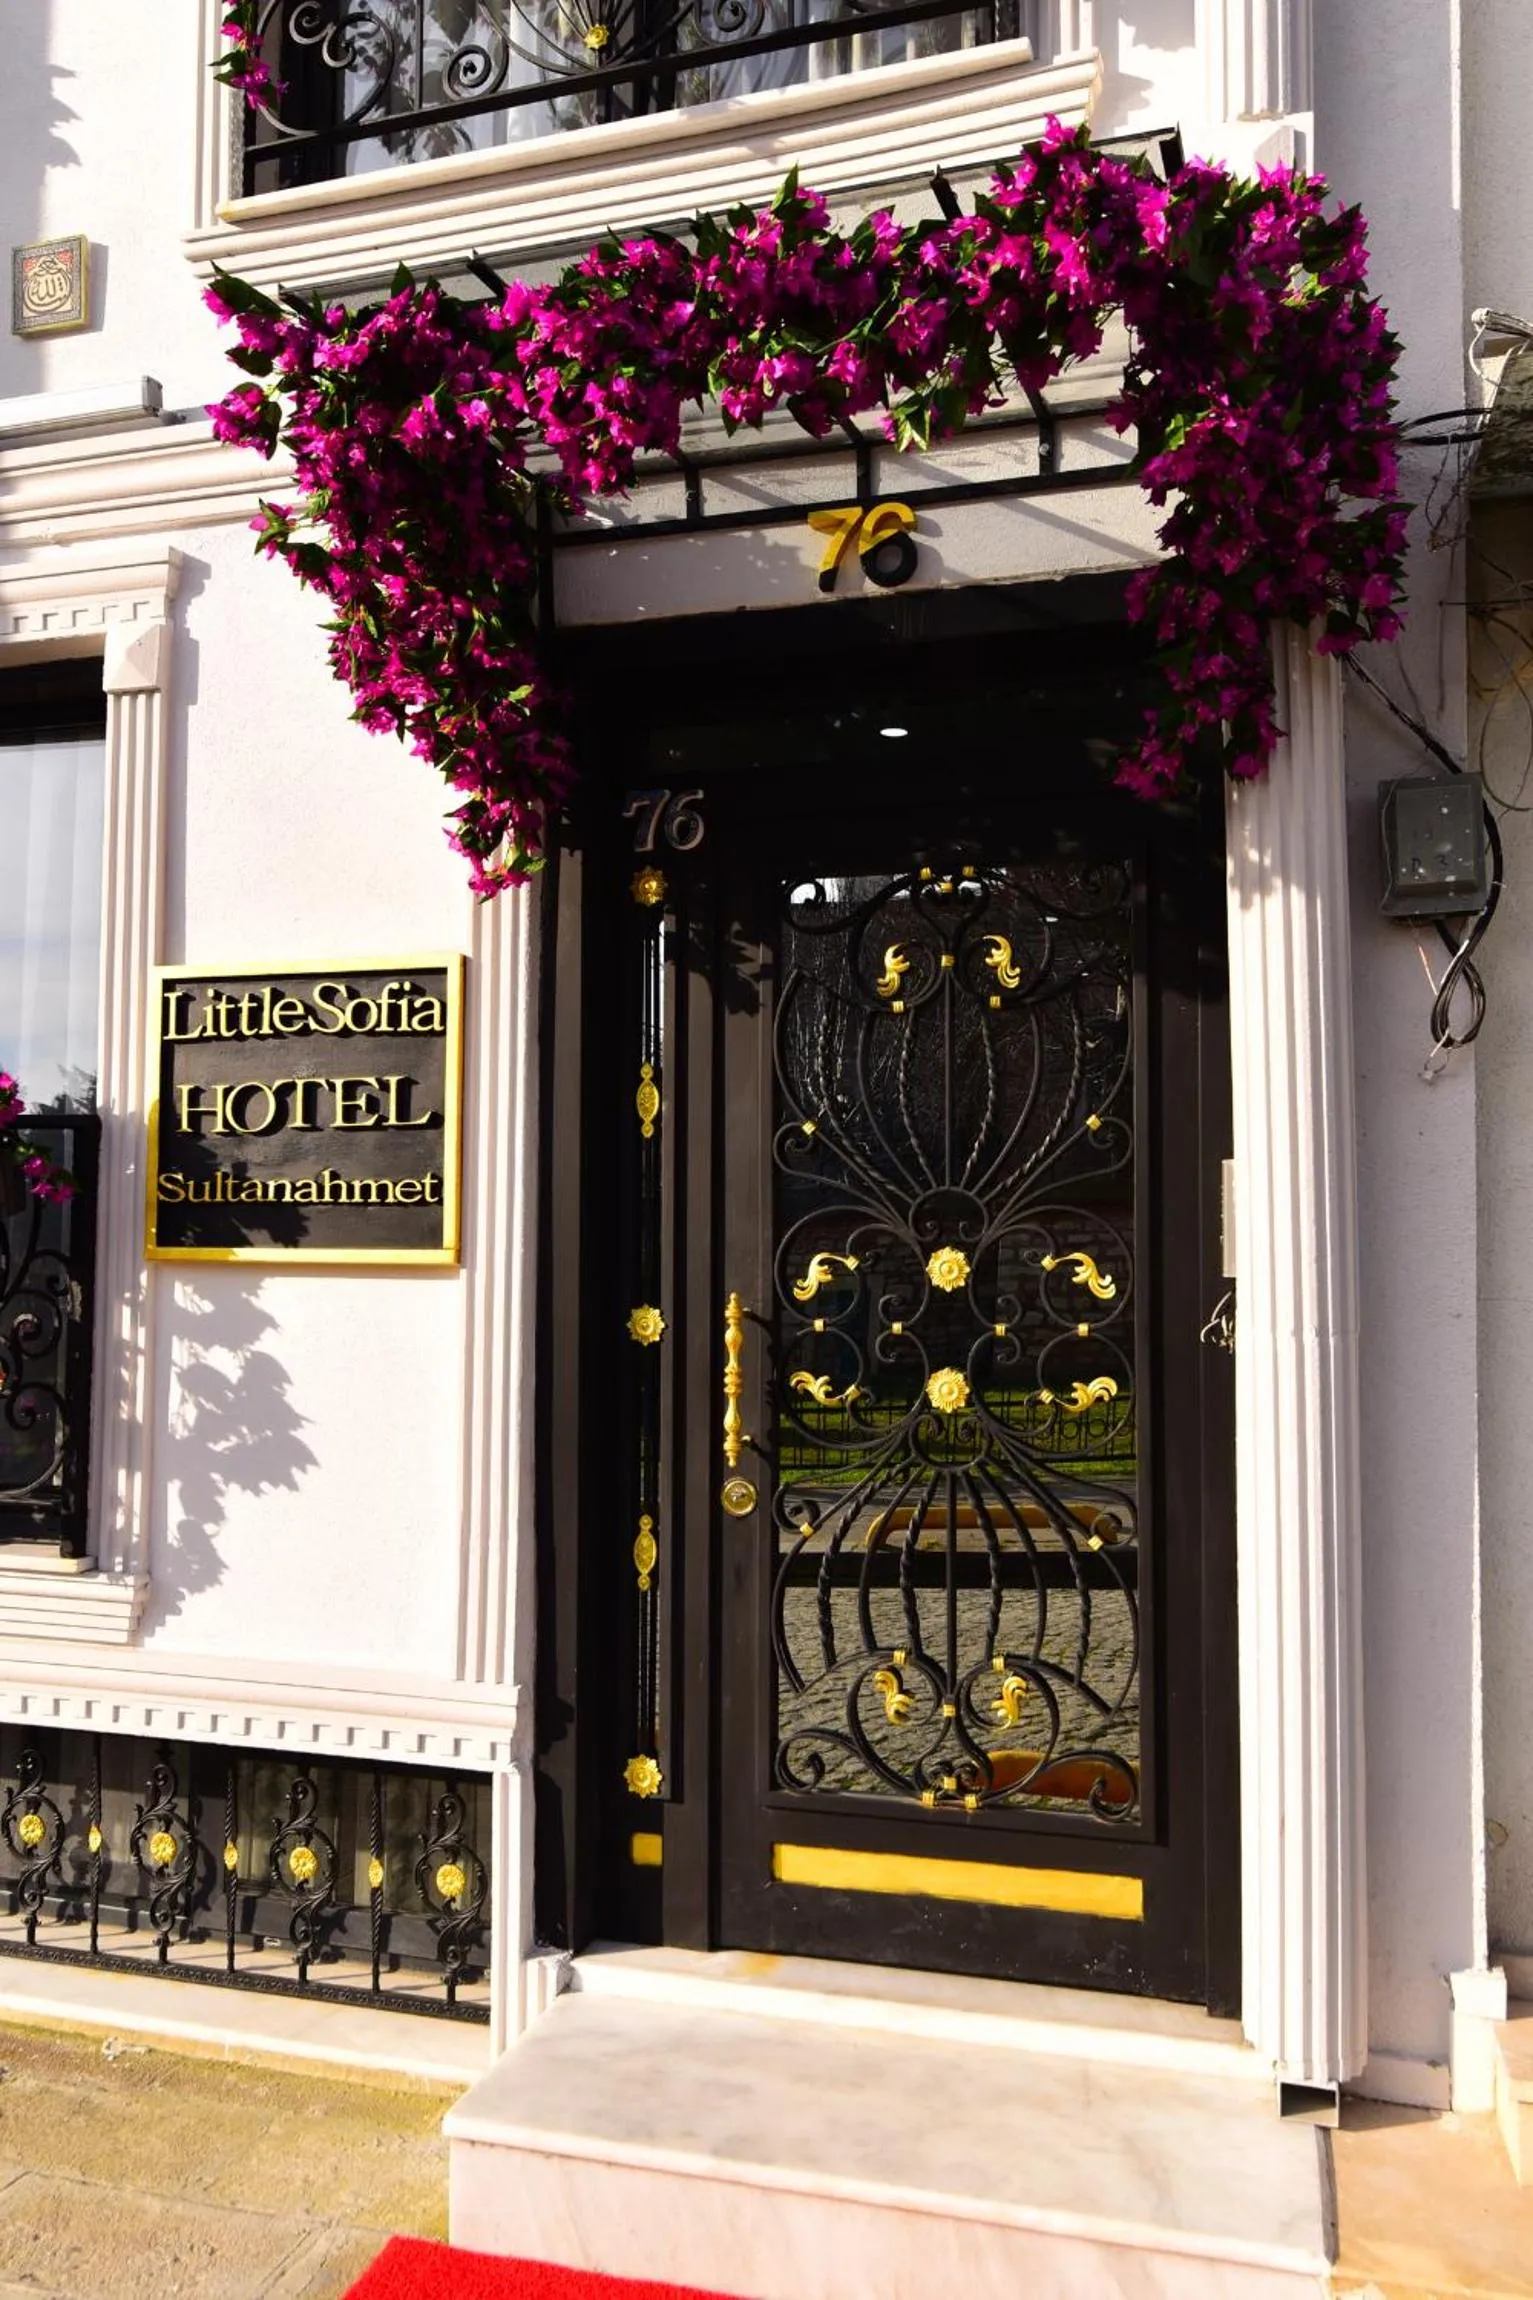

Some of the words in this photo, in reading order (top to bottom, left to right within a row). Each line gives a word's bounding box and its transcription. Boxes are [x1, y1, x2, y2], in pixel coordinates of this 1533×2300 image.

[807, 502, 918, 592] 76
[622, 788, 705, 852] 76
[175, 1075, 433, 1133] HOTEL
[158, 1168, 440, 1203] Sultanahmet
